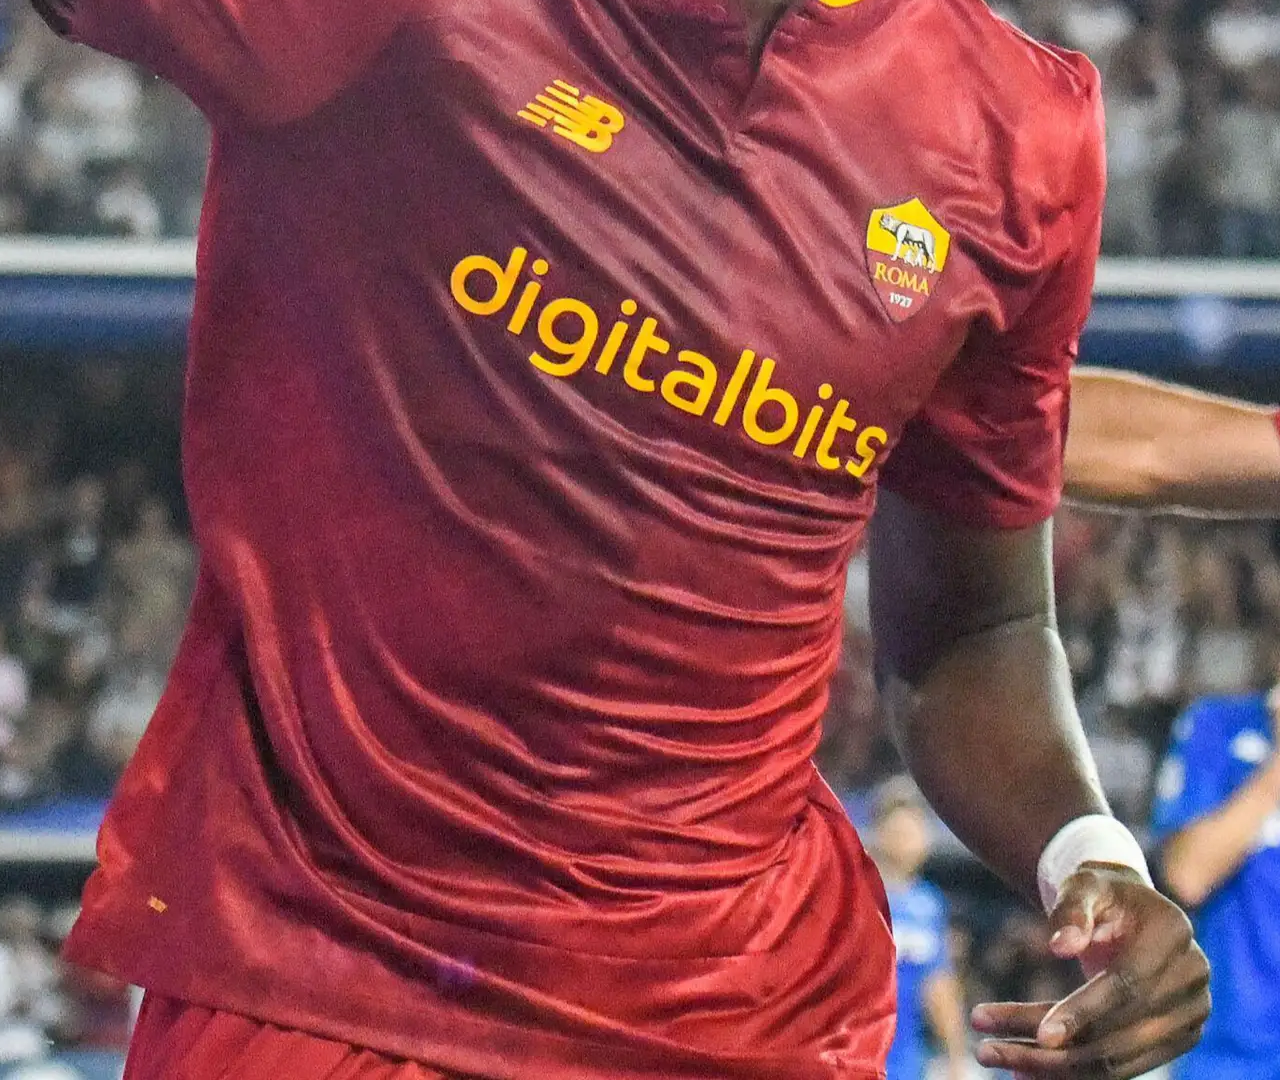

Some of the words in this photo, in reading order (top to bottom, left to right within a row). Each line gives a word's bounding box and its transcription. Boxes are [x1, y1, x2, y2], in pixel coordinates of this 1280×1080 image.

[874, 261, 930, 297] ROMA
[889, 291, 913, 309] 1927
[450, 246, 888, 478] digitalbits
